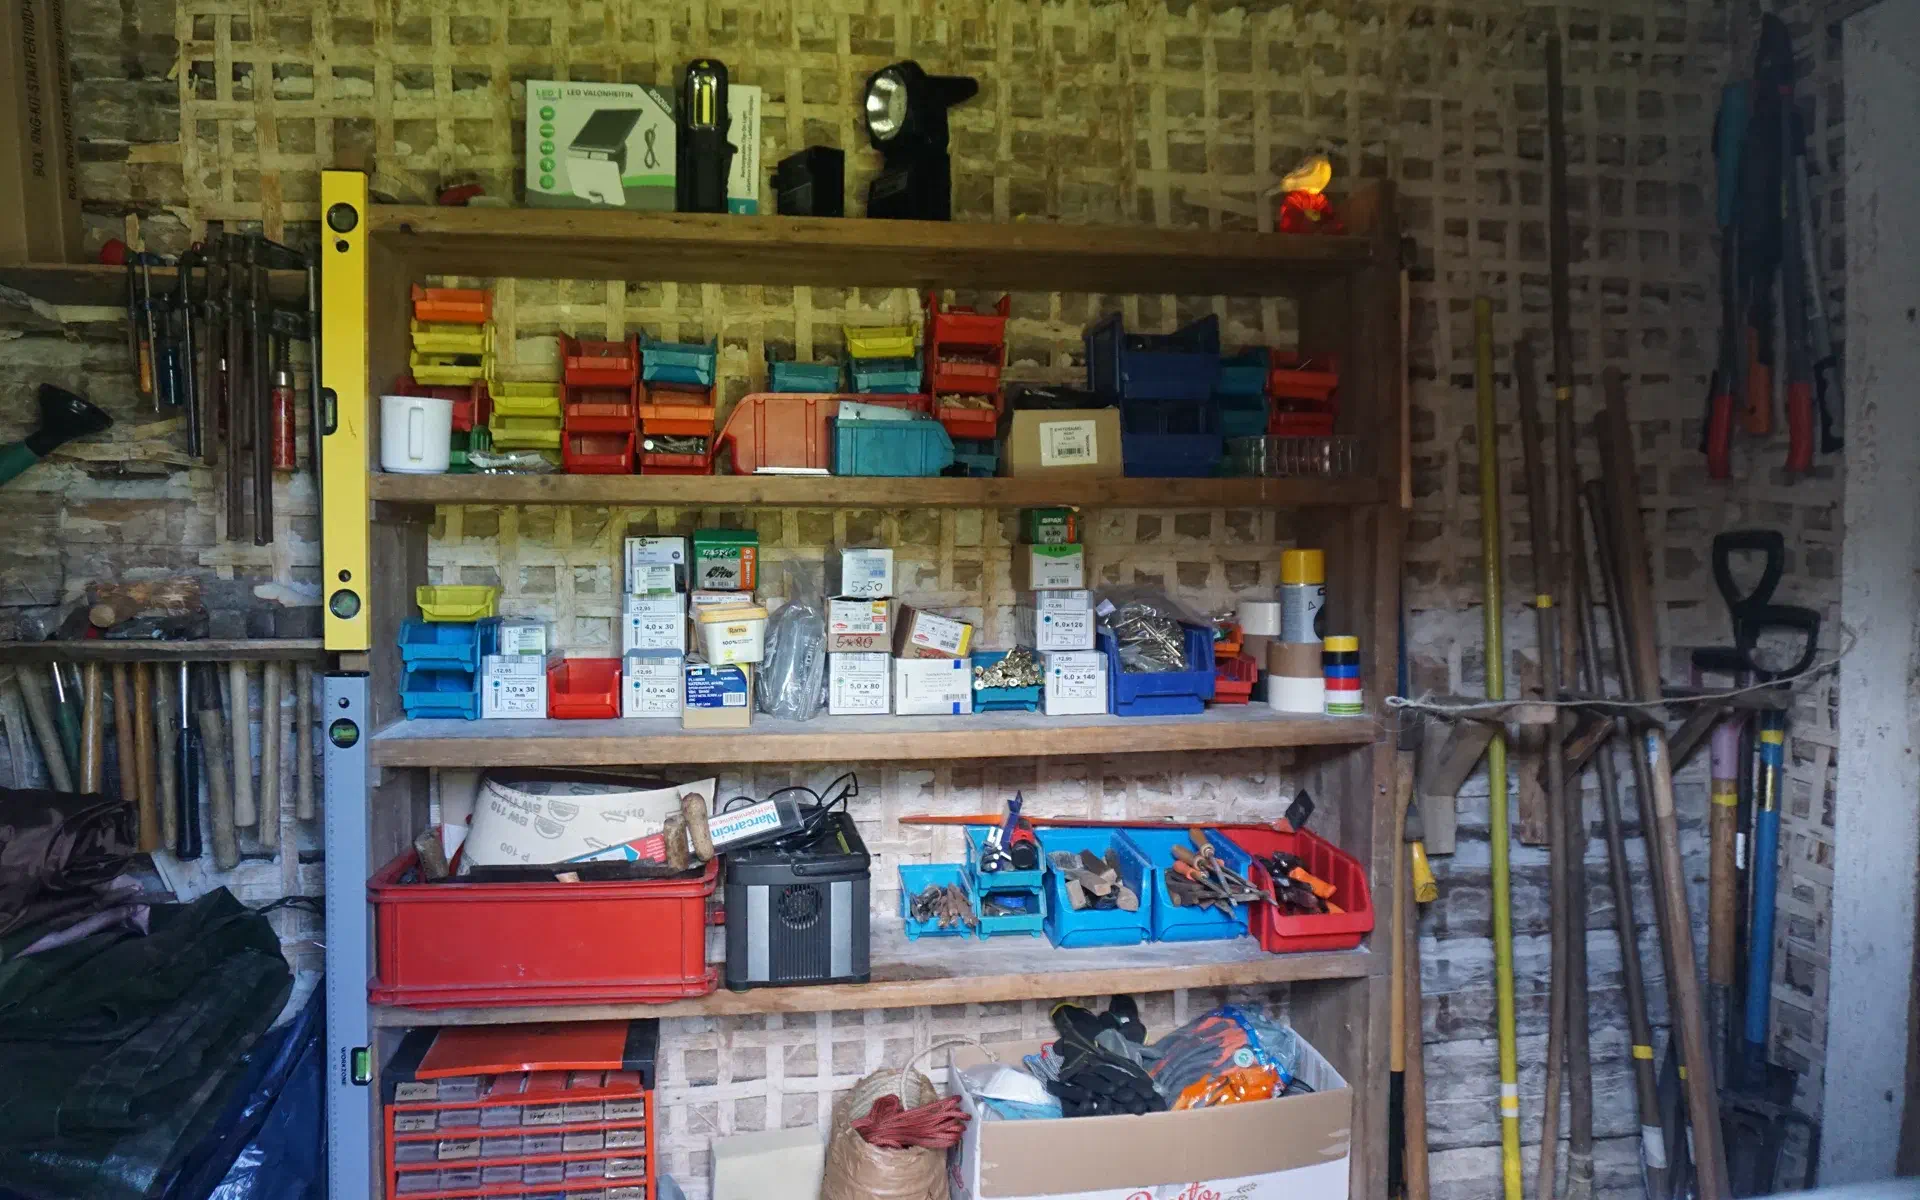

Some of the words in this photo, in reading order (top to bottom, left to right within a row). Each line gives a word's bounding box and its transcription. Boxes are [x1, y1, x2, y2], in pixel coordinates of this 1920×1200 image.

[567, 89, 581, 97] LED
[583, 90, 634, 98] VALONHEITIN
[851, 581, 882, 593] 5x50
[644, 623, 656, 631] 4,0
[728, 626, 747, 634] Rama
[836, 635, 873, 649] 5x80
[505, 686, 517, 694] 3,0
[490, 800, 506, 816] 110
[507, 811, 529, 827] BW
[711, 812, 779, 837] Narcaricin
[500, 842, 518, 857] 100
[521, 852, 530, 863] P
